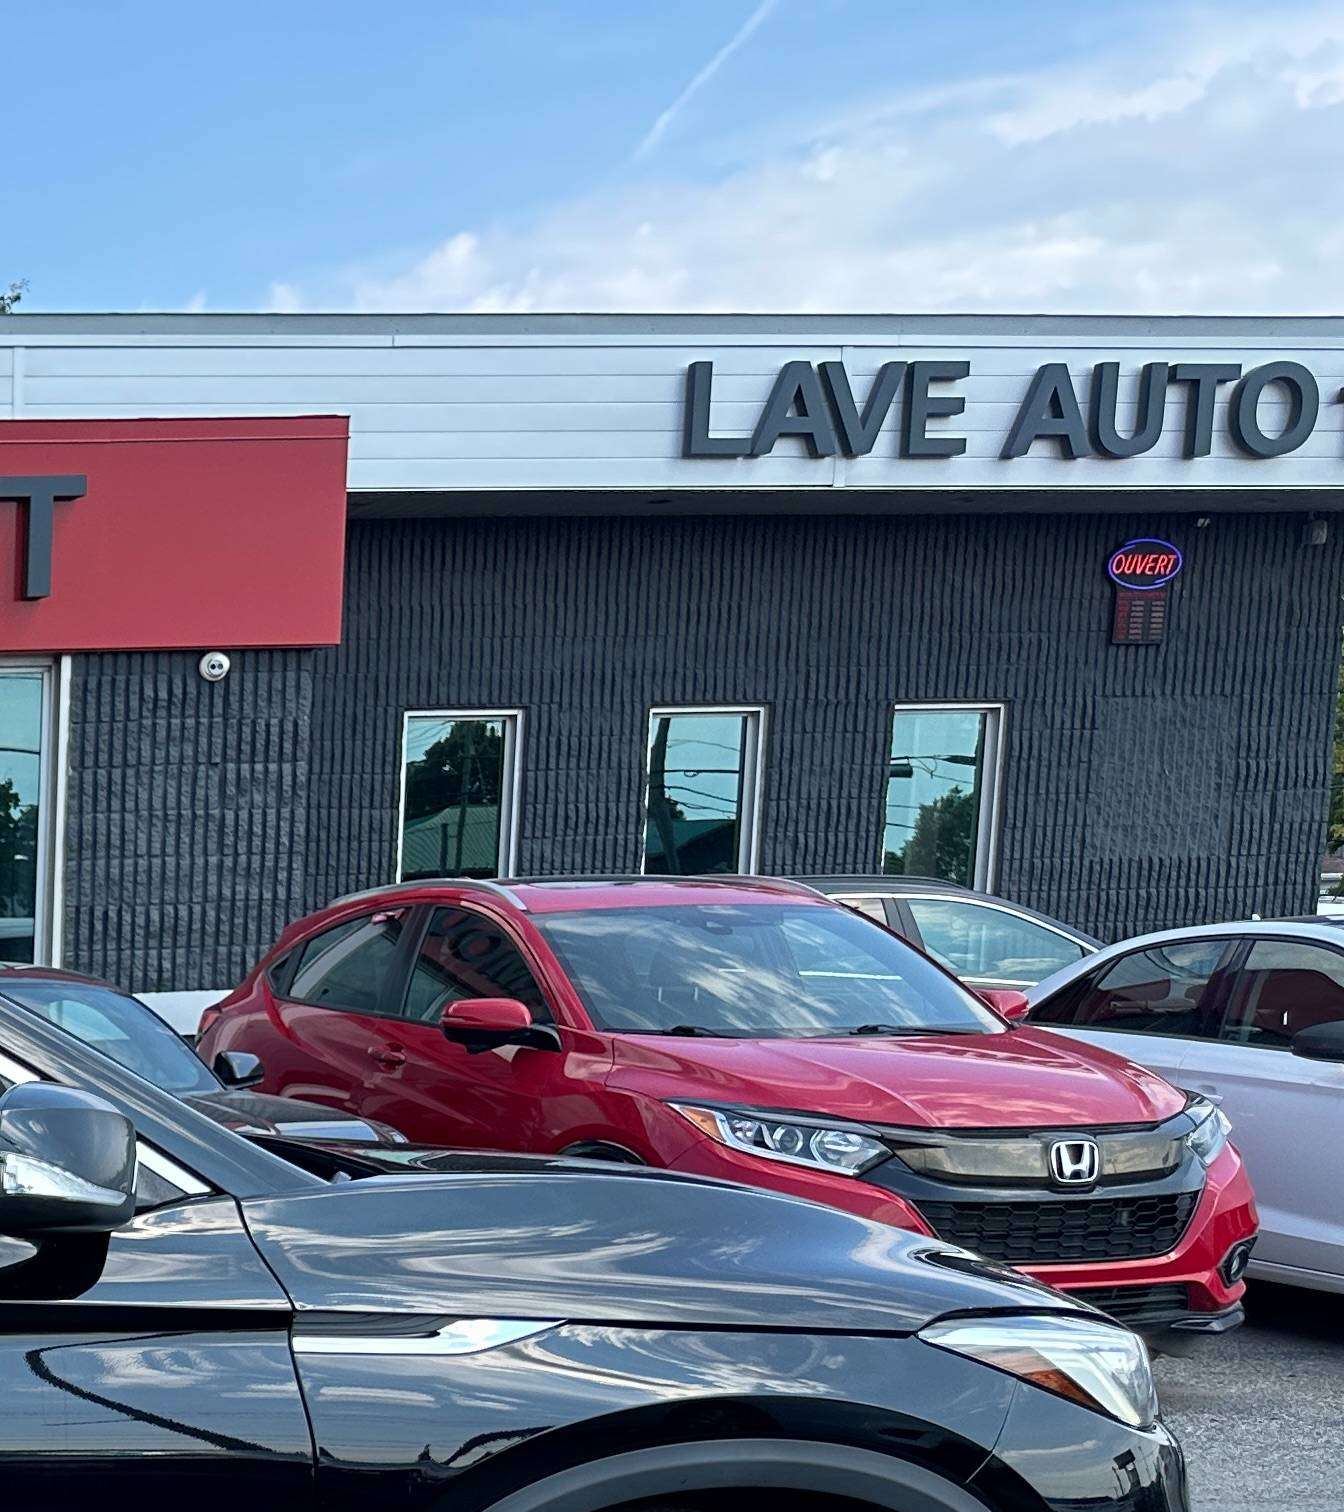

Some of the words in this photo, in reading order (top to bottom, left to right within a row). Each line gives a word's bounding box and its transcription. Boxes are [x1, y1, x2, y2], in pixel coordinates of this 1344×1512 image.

[683, 360, 971, 458] LAVE
[1000, 360, 1320, 460] AUTO
[1112, 553, 1178, 576] OUVERT
